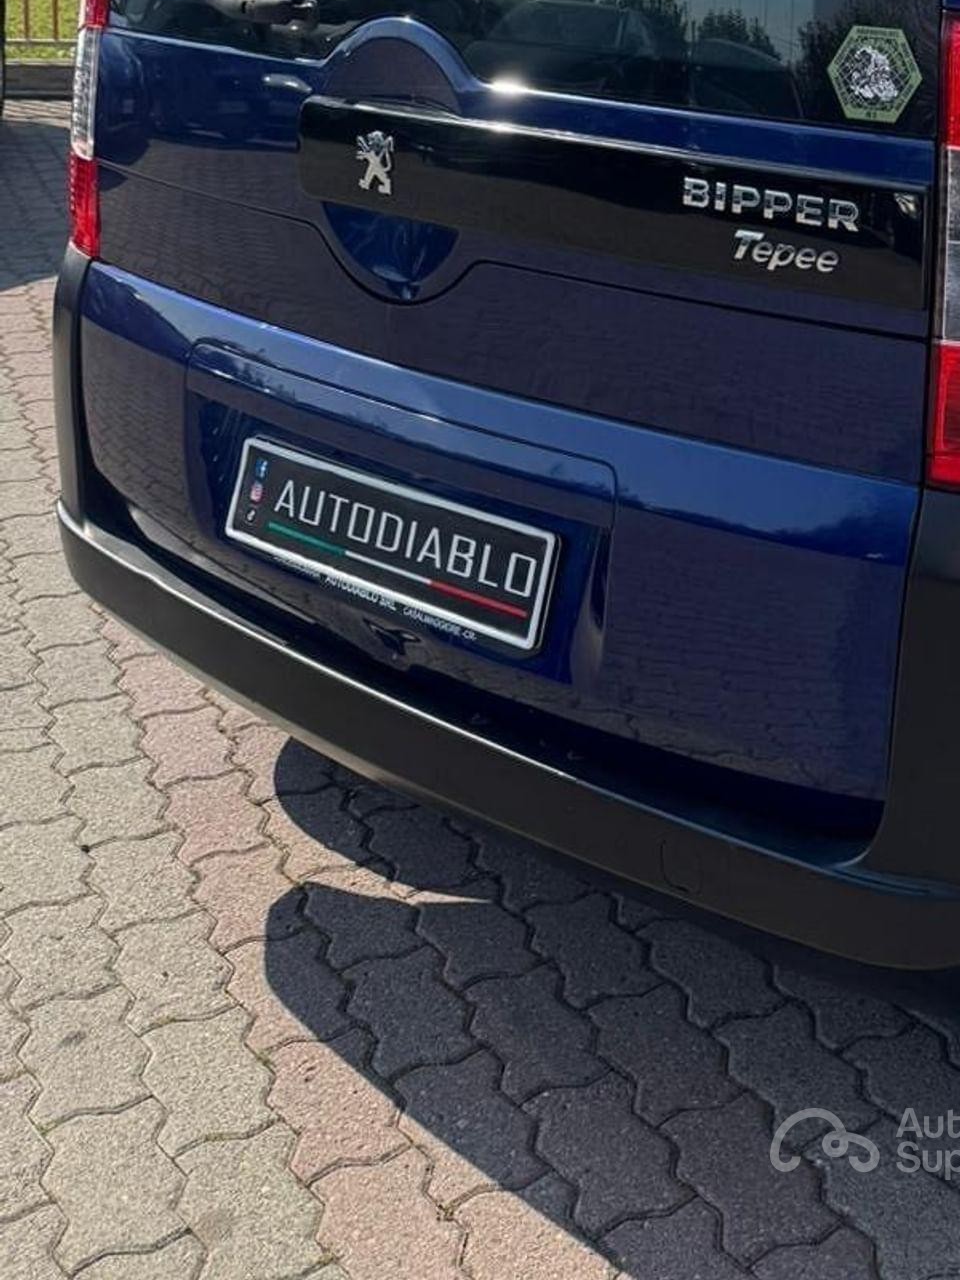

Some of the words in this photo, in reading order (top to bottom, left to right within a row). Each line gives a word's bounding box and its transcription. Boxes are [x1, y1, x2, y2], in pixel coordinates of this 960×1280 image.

[683, 176, 859, 232] BIPPER
[733, 229, 839, 272] Tepee
[273, 479, 537, 598] AUTODIABLO
